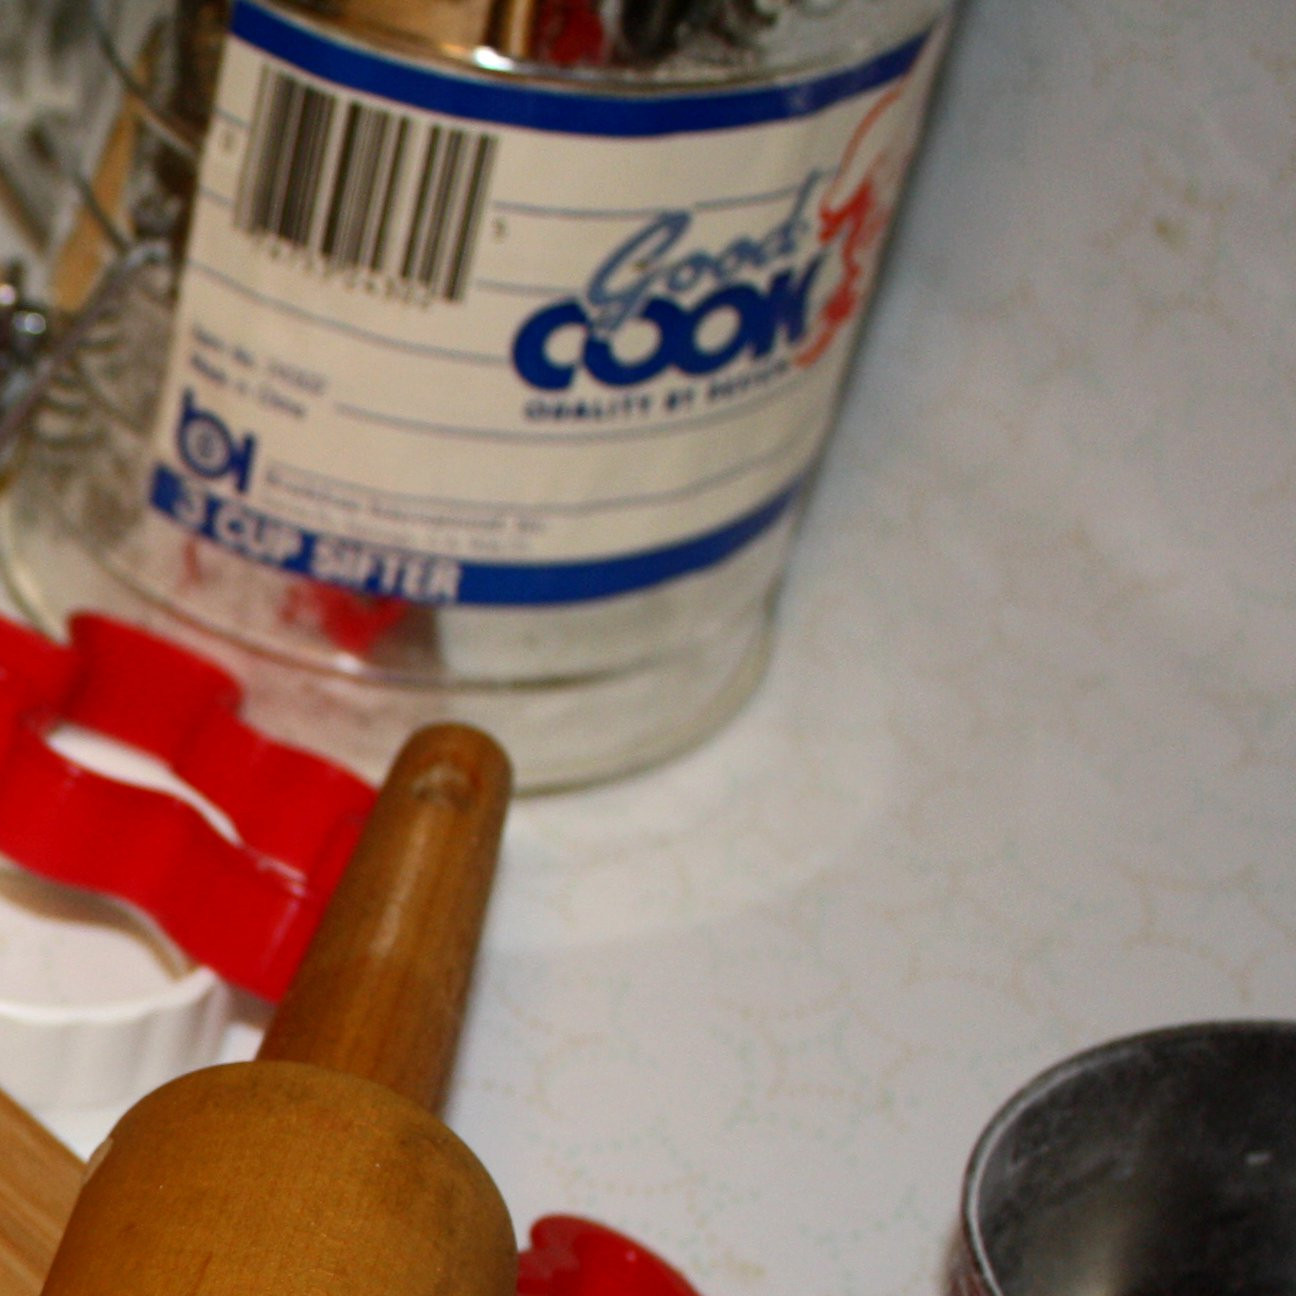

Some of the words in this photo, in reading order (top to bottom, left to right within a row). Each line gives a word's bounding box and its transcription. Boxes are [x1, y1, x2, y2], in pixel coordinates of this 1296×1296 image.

[586, 168, 826, 331] Good
[512, 250, 827, 391] COOK
[524, 393, 652, 421] QUALITY
[665, 388, 695, 412] BY
[212, 502, 304, 567] CUP
[311, 537, 459, 602] SIFTER
